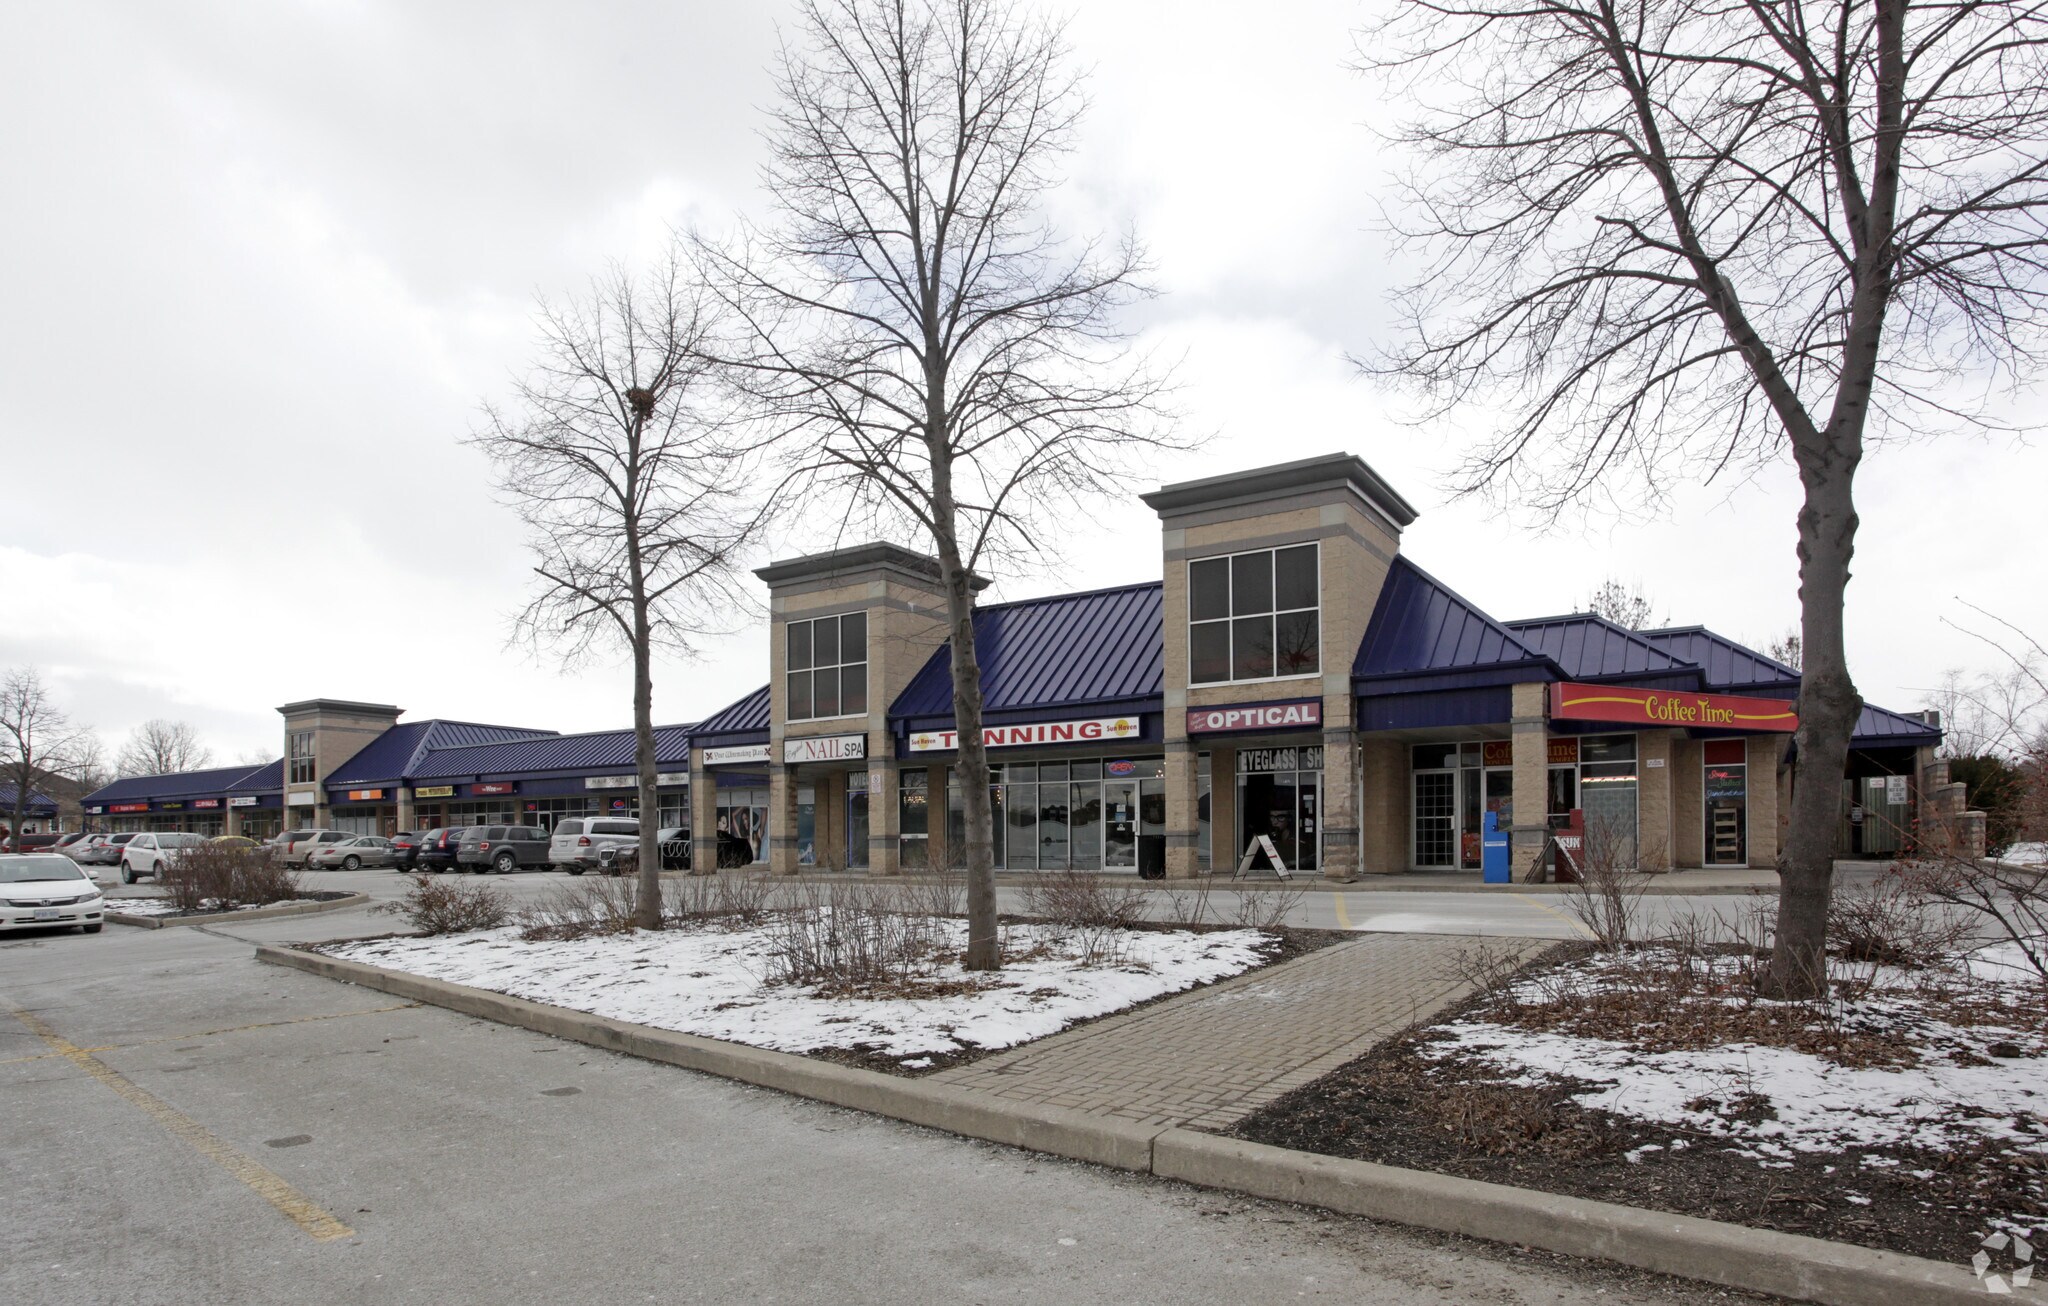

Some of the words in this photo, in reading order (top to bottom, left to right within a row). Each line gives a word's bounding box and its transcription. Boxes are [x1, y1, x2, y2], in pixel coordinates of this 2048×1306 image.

[1206, 705, 1317, 729] OPTICAL
[1645, 695, 1696, 721] Coffee
[1698, 697, 1734, 723] Time
[938, 722, 1102, 748] TNNING
[805, 739, 844, 760] NAIL
[844, 742, 863, 757] SPA
[1241, 748, 1296, 771] EYEGLASS
[1547, 741, 1577, 756] ime
